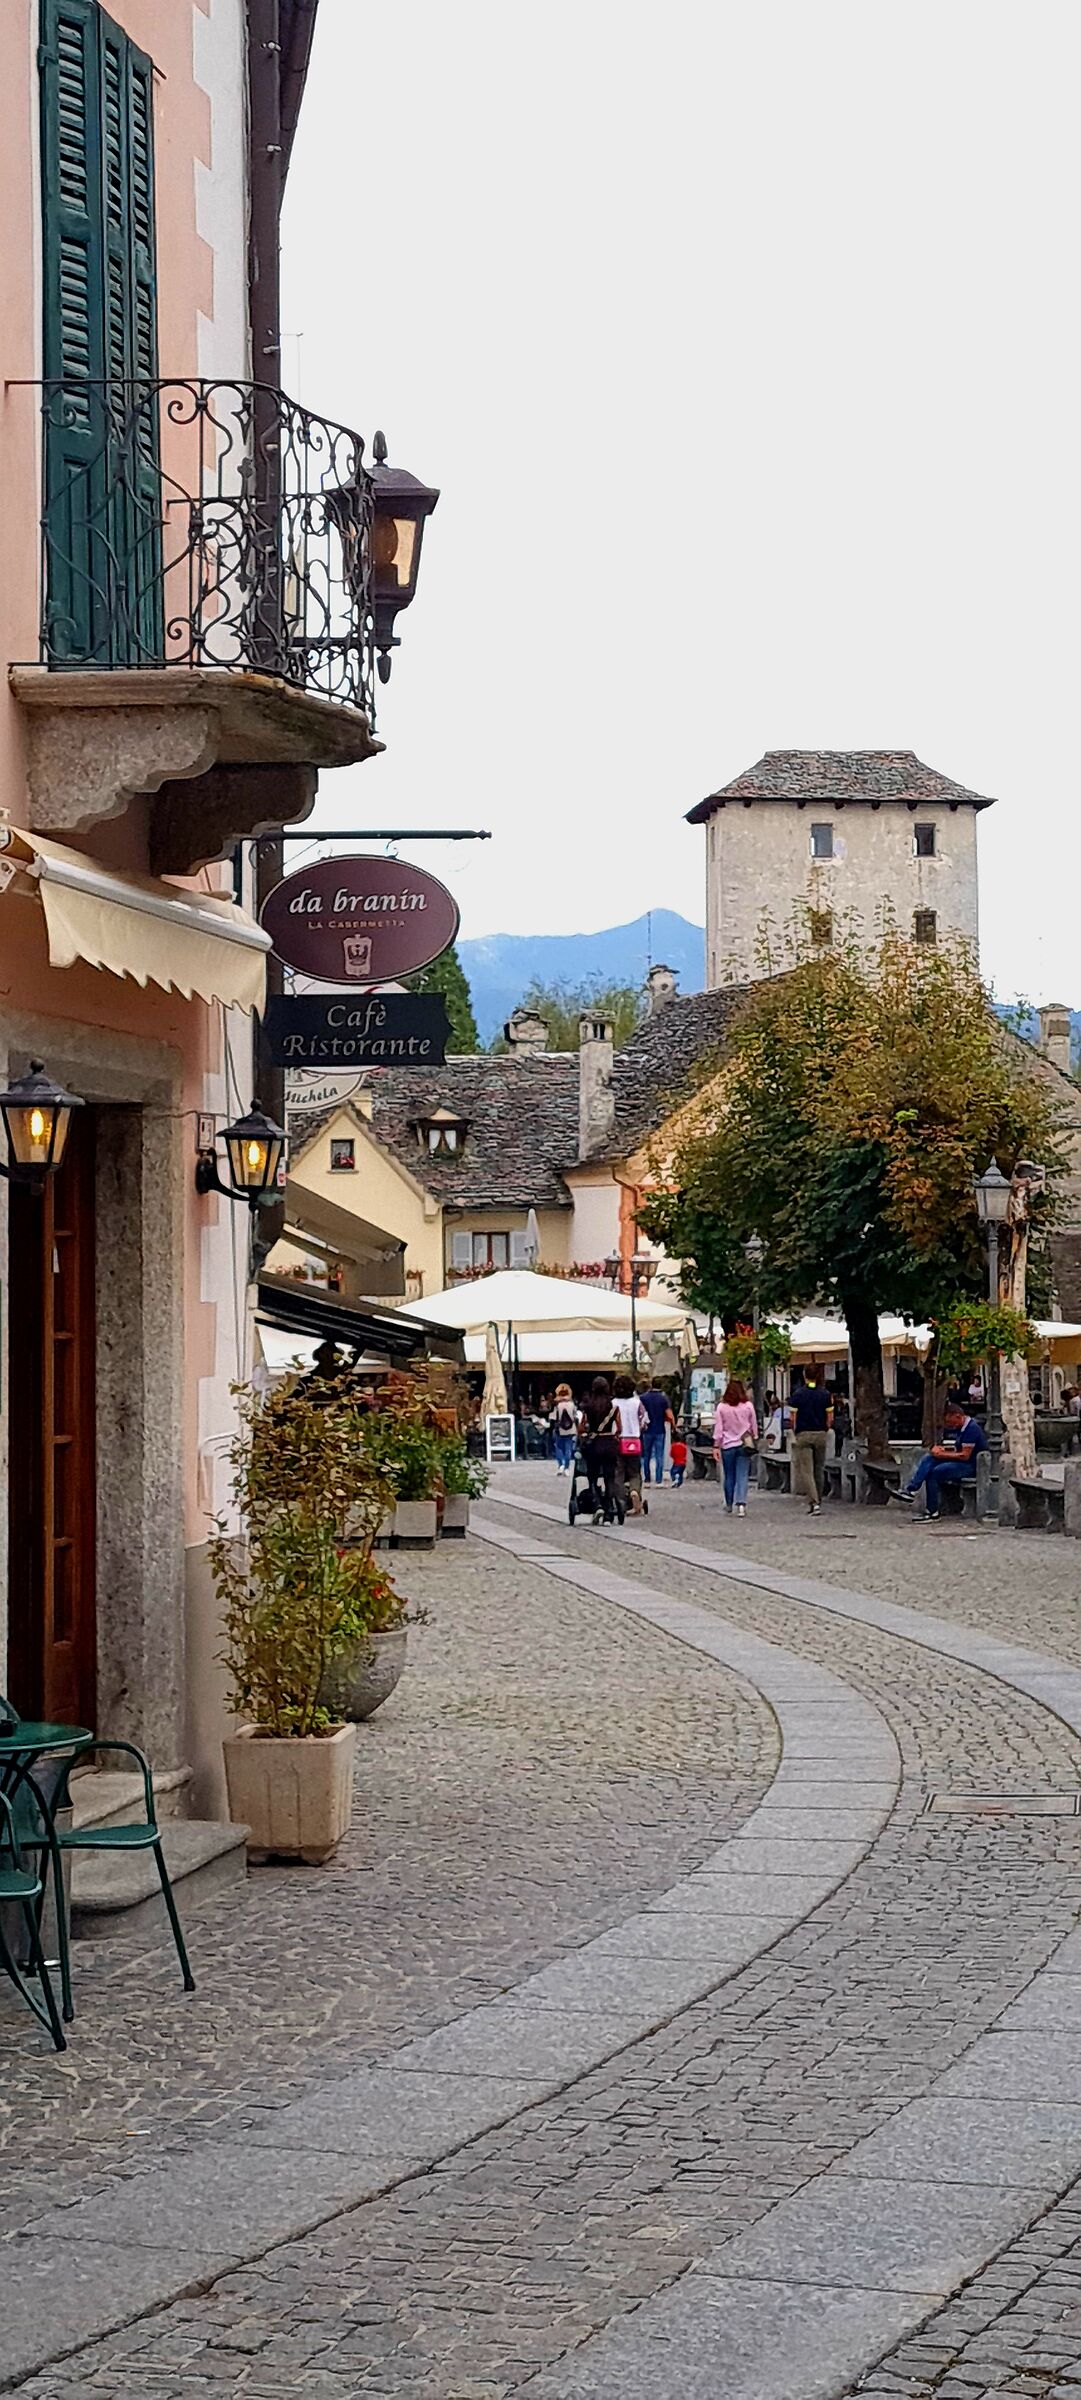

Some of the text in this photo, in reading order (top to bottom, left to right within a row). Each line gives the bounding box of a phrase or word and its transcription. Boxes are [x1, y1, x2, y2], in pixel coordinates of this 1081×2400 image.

[289, 888, 427, 914] da branin
[307, 921, 323, 930] LA
[327, 999, 386, 1038] Cafè
[283, 1034, 431, 1056] Ristorante
